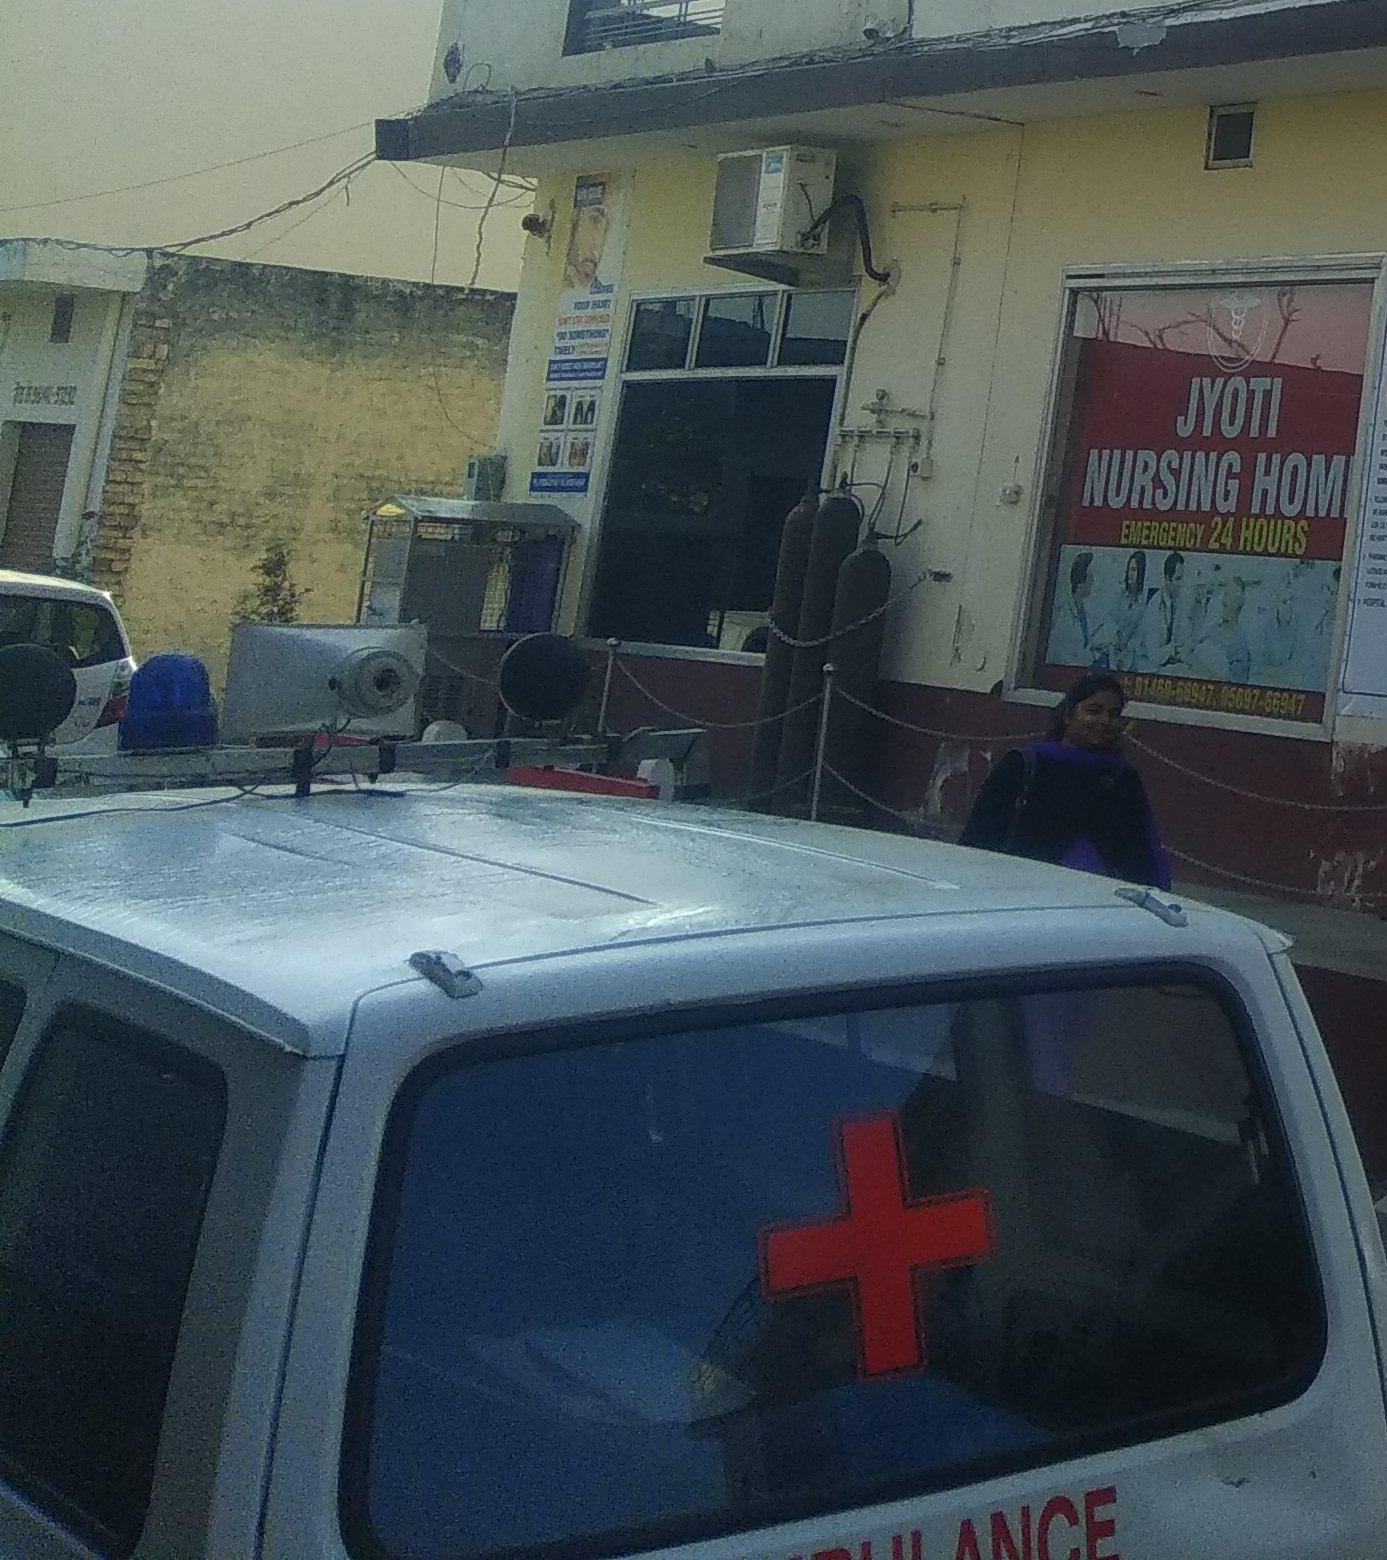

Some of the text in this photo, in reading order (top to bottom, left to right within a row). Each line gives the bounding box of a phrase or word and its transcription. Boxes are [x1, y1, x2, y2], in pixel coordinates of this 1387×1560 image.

[1176, 375, 1283, 438] JYOTI
[1081, 448, 1354, 520] NURSING HOM
[1120, 516, 1309, 555] EMERGENCY 24 HOURS
